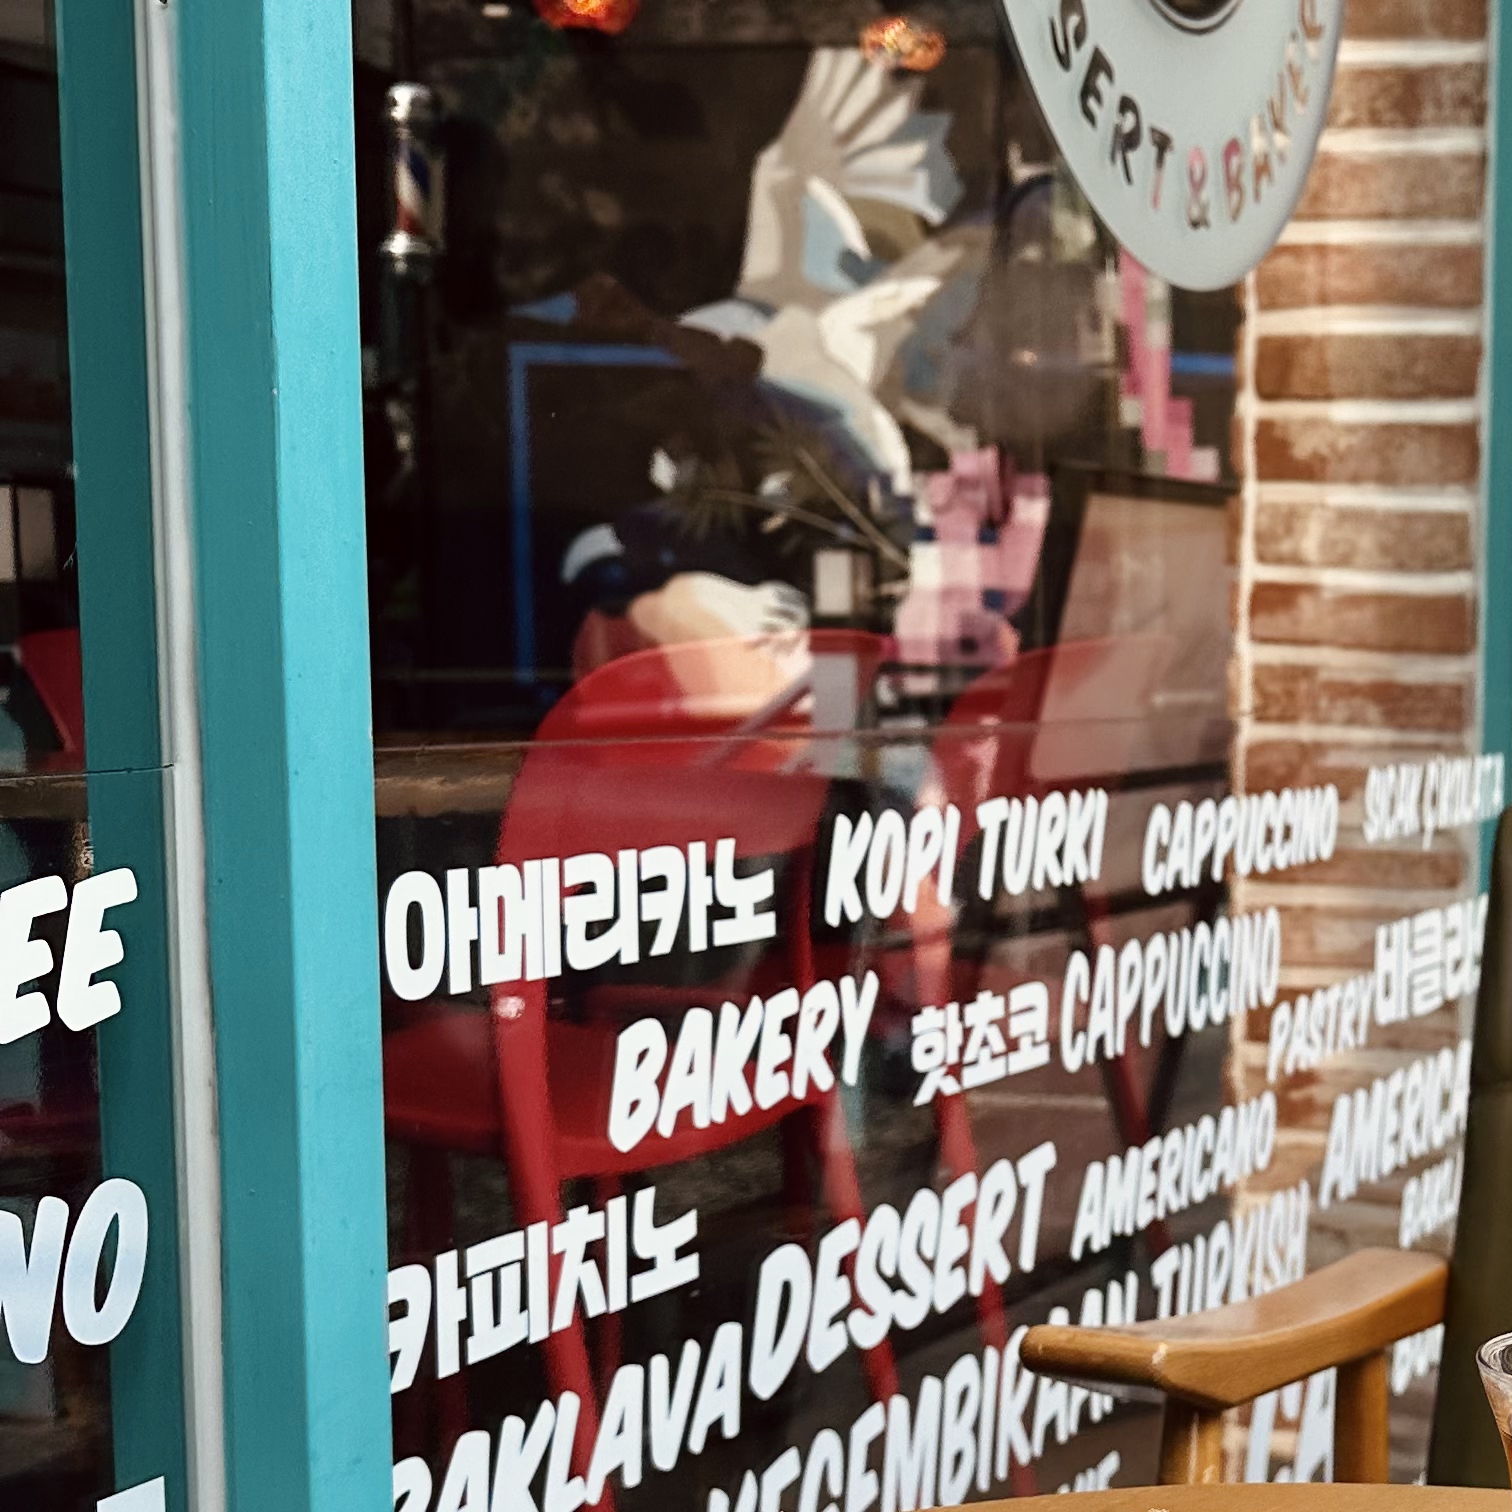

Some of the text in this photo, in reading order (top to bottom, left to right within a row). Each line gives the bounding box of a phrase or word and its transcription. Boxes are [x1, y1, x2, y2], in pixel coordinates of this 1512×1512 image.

[383, 838, 776, 1001] 아메리카노
[824, 788, 1108, 927] KOPI TURKI
[1142, 783, 1339, 896] CAPPUCCINO
[608, 970, 879, 1153] BAKERY
[912, 981, 1050, 1107] 핫초코
[1060, 906, 1281, 1074] CAPPUCCINO
[1267, 970, 1375, 1083] PASTRY
[1070, 1091, 1277, 1261] AMERICANO
[387, 1186, 699, 1394] 카피치노
[749, 1142, 1057, 1400] DESSERT
